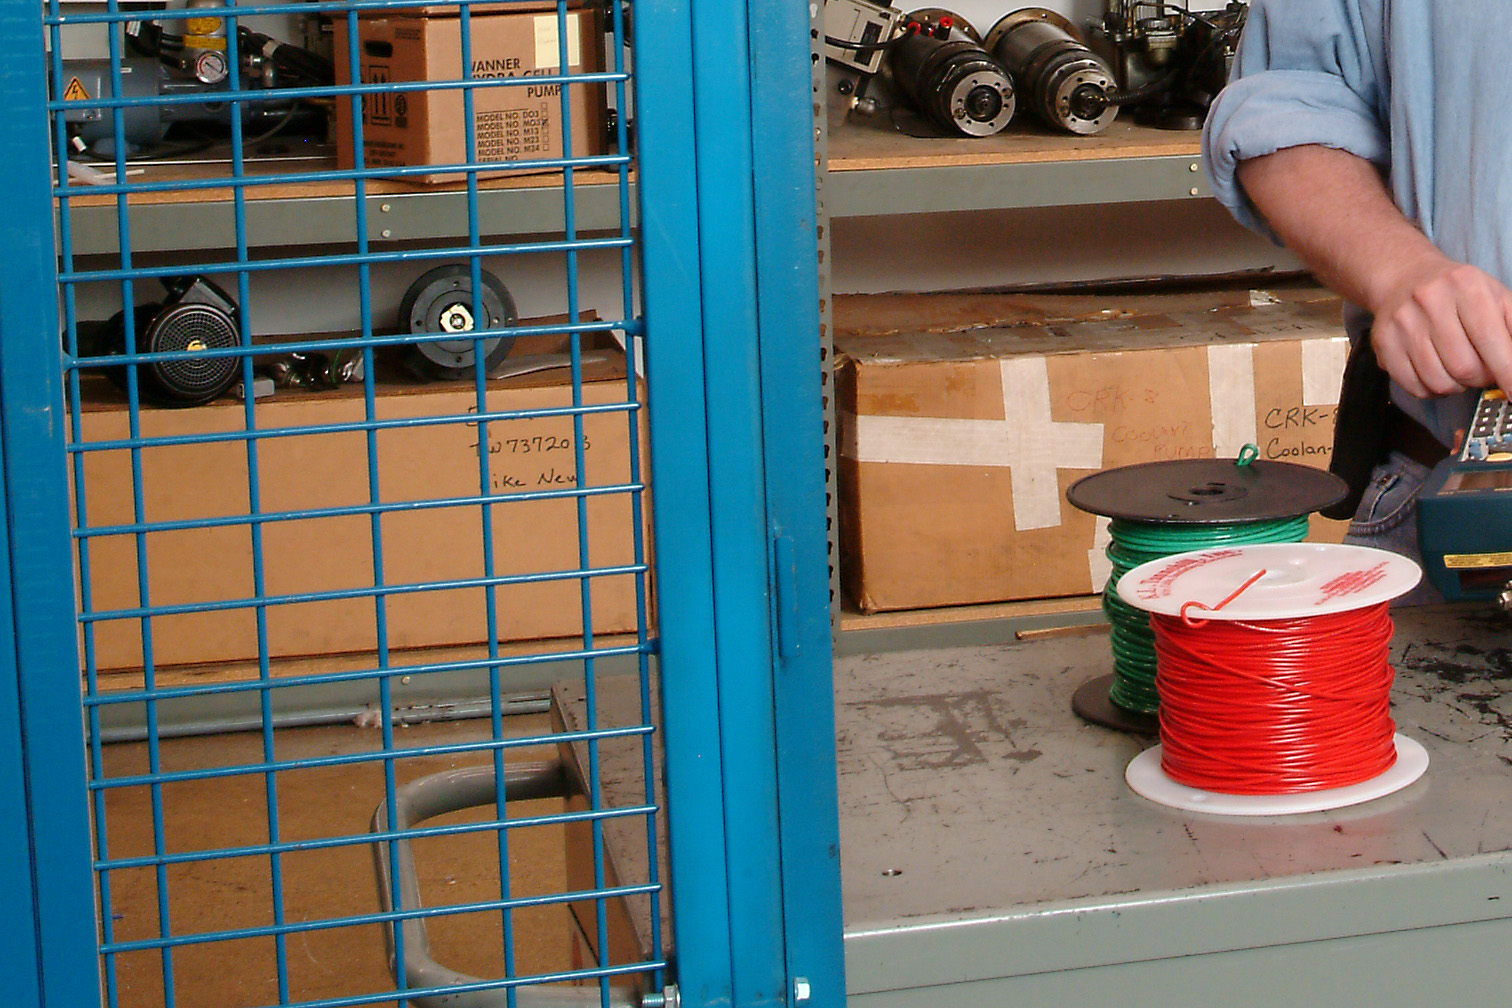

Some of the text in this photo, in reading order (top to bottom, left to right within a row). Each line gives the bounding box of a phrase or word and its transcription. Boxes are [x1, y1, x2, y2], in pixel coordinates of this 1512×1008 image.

[527, 85, 562, 98] PUMP
[477, 122, 503, 131] MODEL
[477, 131, 504, 139] MODEL
[478, 139, 504, 148] MODEL
[478, 148, 505, 156] MODEL
[493, 474, 527, 489] ike
